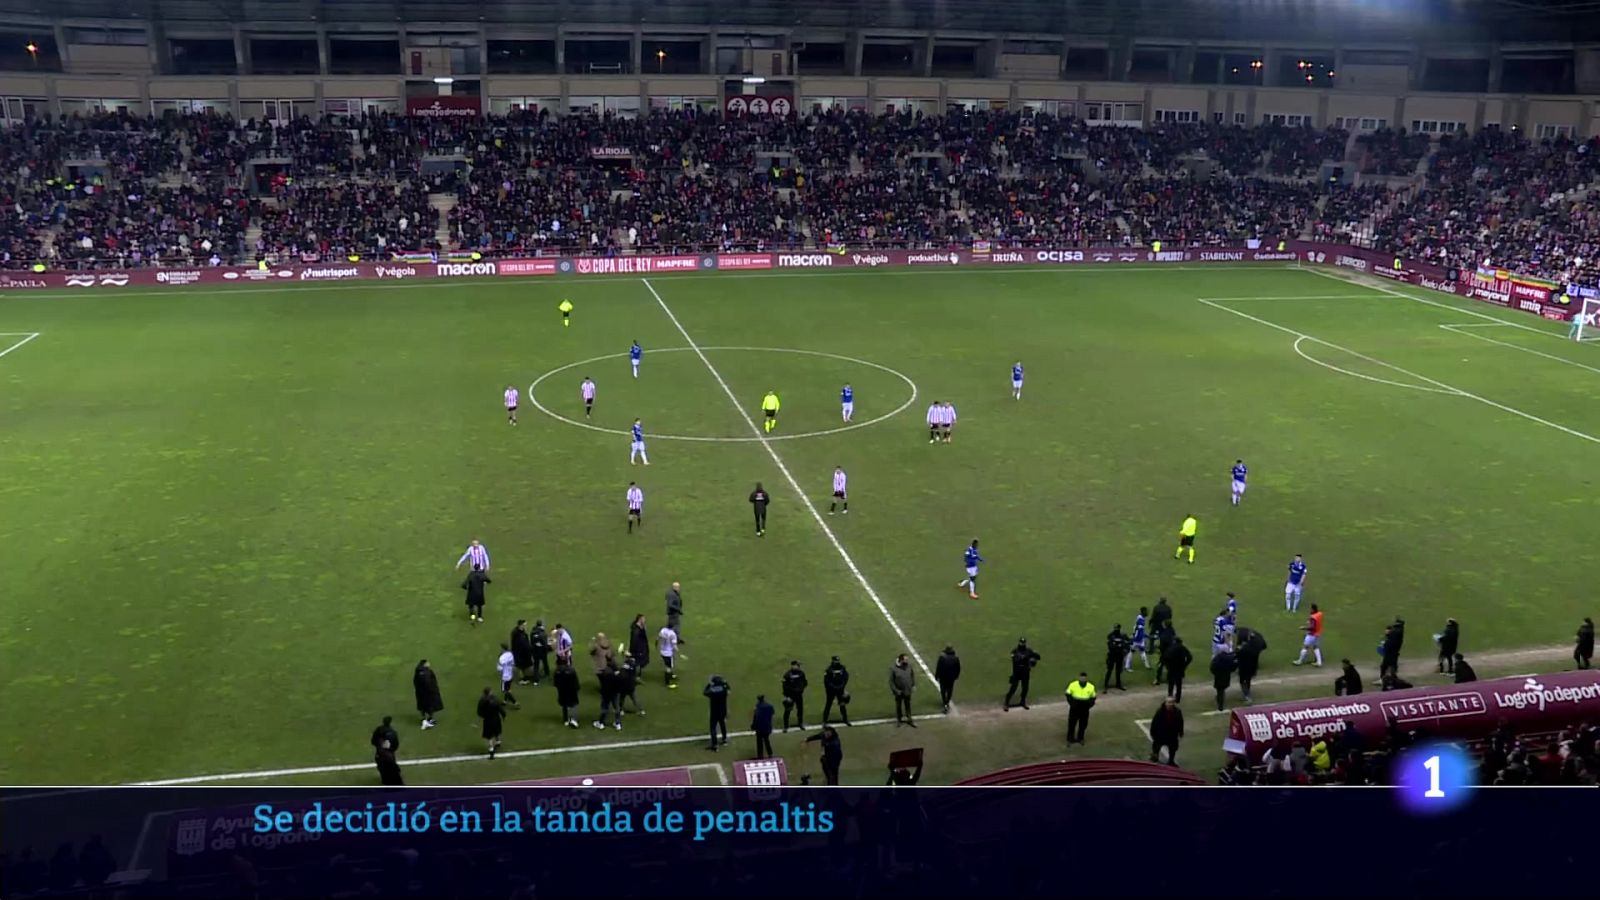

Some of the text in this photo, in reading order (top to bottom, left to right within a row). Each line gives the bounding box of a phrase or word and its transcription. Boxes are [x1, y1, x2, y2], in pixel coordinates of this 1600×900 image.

[593, 147, 630, 155] LA RIOJA
[779, 253, 832, 267] macron
[908, 254, 949, 265] podoactiva
[992, 252, 1024, 262] IRUÑA
[1200, 252, 1243, 261] STABILINAT
[437, 262, 496, 276] macron
[592, 256, 651, 273] COPA DEL REY
[656, 259, 696, 269] MAPFRE
[311, 267, 358, 279] nutrisport
[10, 280, 47, 288] PAULA
[1475, 287, 1510, 302] mayoral
[1515, 285, 1547, 299] MAPFRE
[1271, 702, 1371, 725] Ayuntamiento
[1389, 696, 1482, 718] VISITANTE
[1276, 718, 1347, 739] de Logroñ
